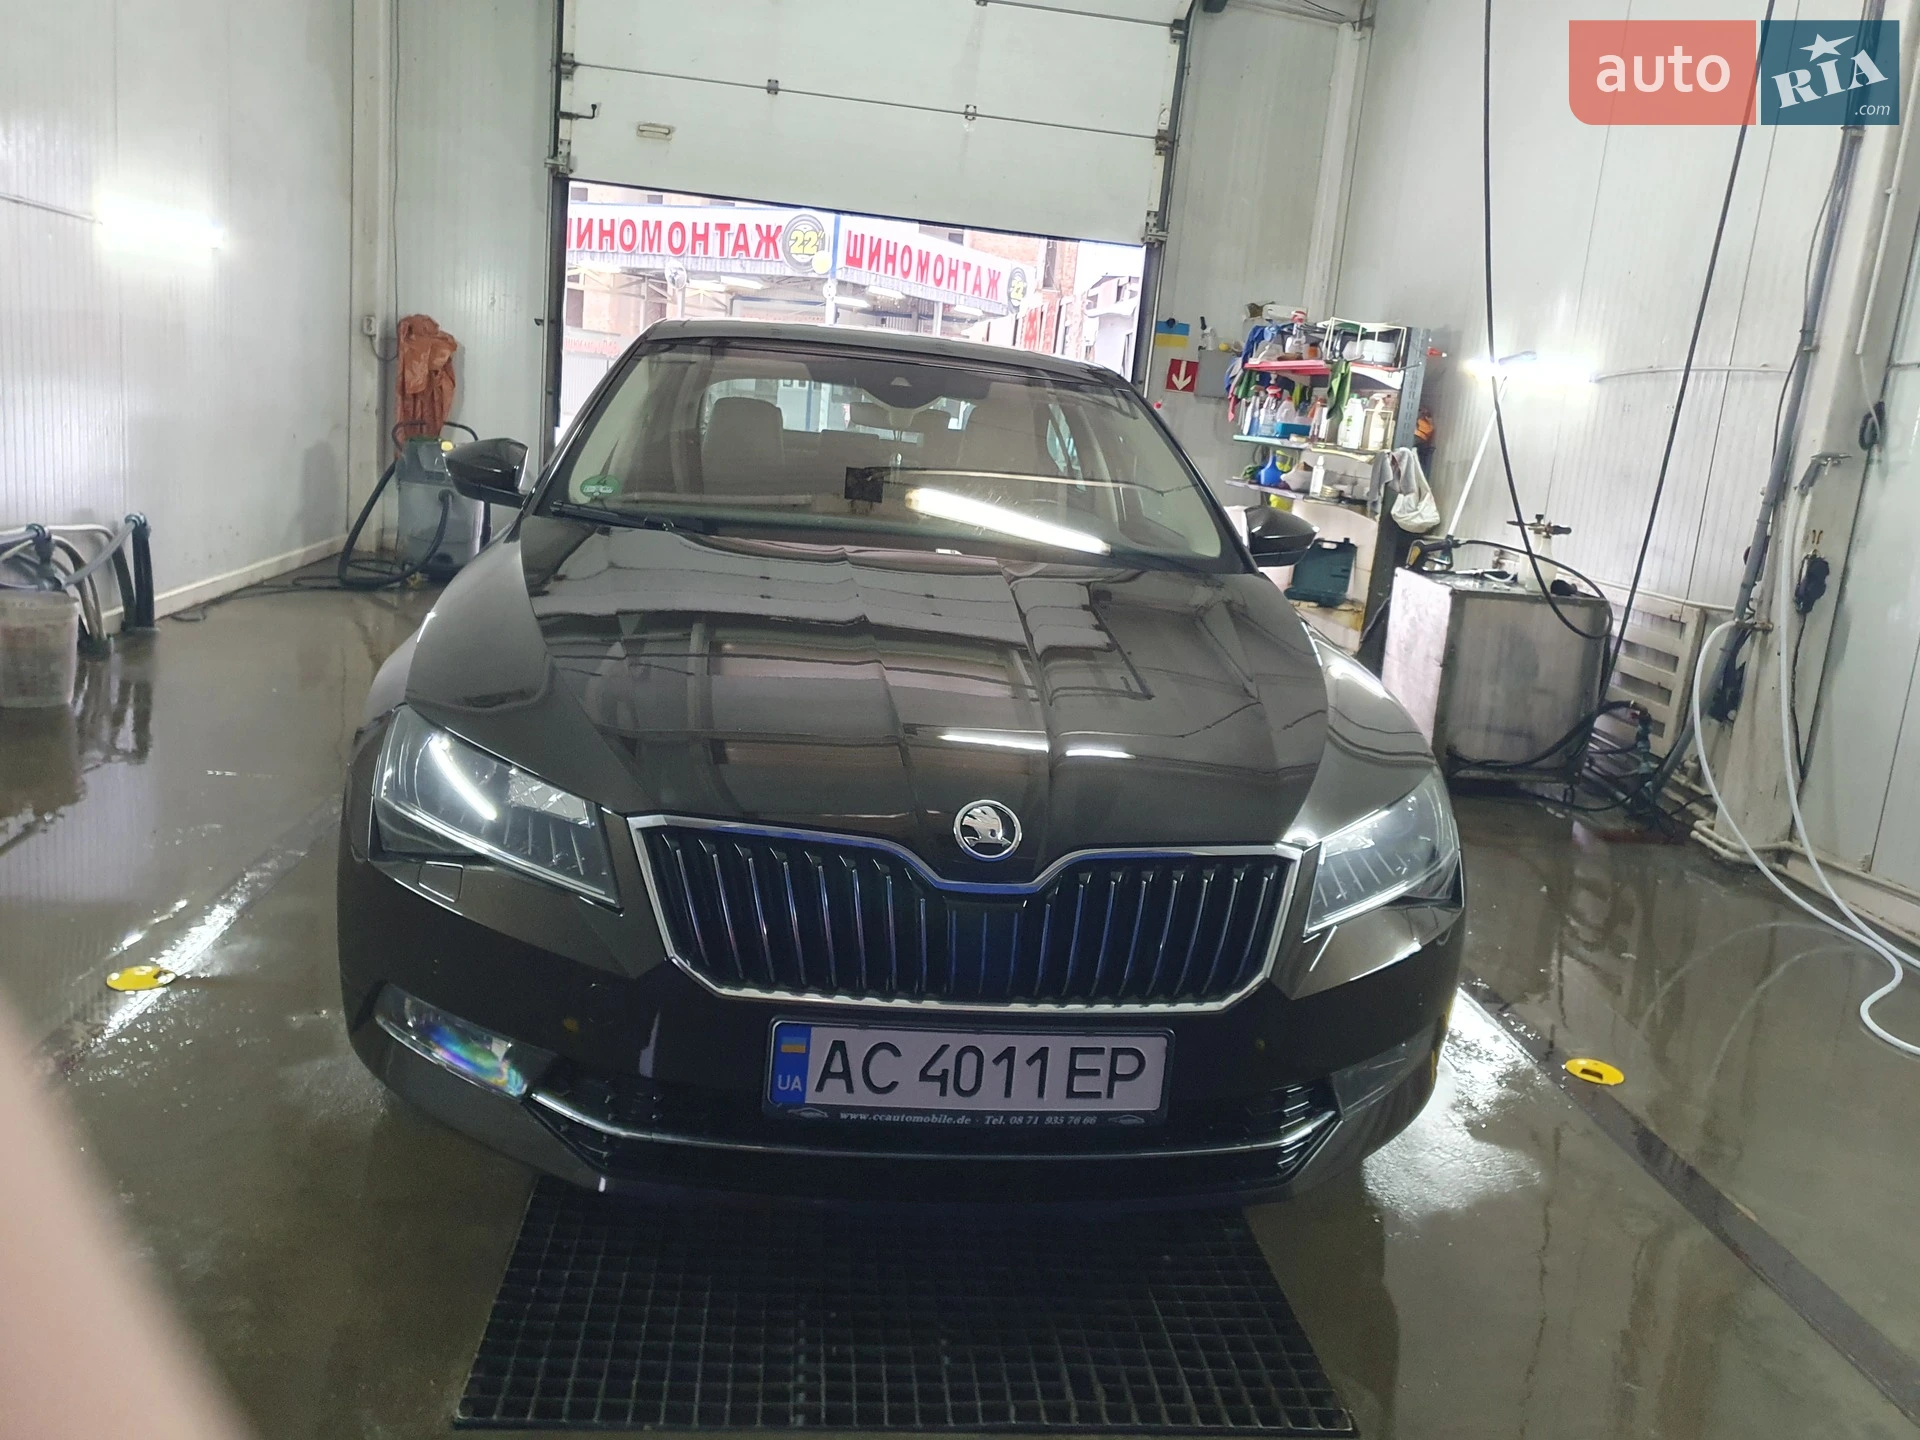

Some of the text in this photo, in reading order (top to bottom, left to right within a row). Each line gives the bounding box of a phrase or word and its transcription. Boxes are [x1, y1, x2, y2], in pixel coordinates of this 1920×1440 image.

[845, 230, 1001, 301] ШИНОМОНТАЖ
[776, 1073, 803, 1092] UA
[814, 1039, 1147, 1099] AC 4011 EP
[839, 1111, 972, 1125] www.ccautomobile.de
[983, 1115, 1006, 1125] Tel.
